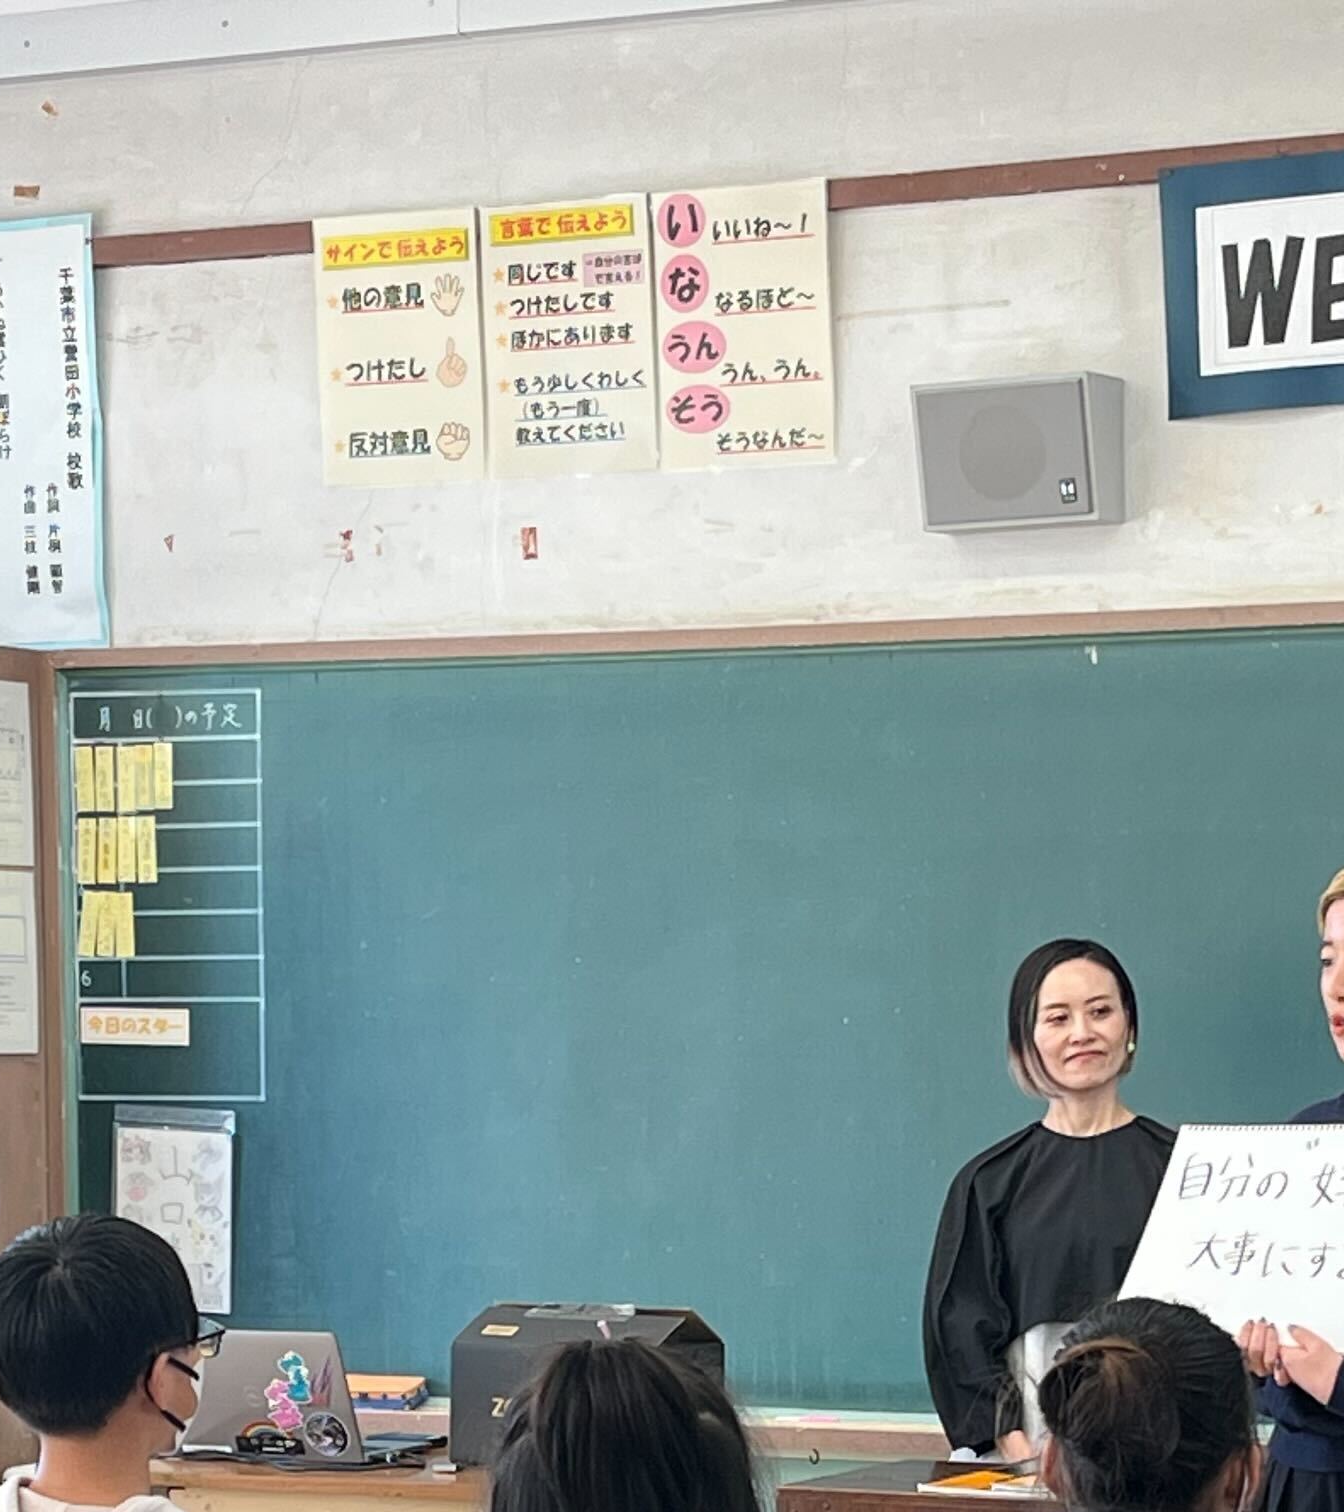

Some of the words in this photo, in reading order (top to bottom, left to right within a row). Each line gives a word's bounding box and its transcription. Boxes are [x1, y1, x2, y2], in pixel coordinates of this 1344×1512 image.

[666, 204, 699, 242] い
[508, 261, 577, 286] 同じです
[668, 266, 701, 304] な
[342, 282, 424, 311] 他の意見
[511, 322, 634, 350] ほかにあります
[667, 333, 719, 363] うん
[514, 370, 646, 395] もう少しくわしく
[671, 394, 723, 424] そう
[349, 428, 431, 457] 反対意見
[516, 422, 625, 445] 教えてください
[66, 452, 84, 489] 校歌
[99, 707, 110, 731] 月
[81, 971, 92, 986] 6
[87, 1015, 185, 1035] 今日のスター
